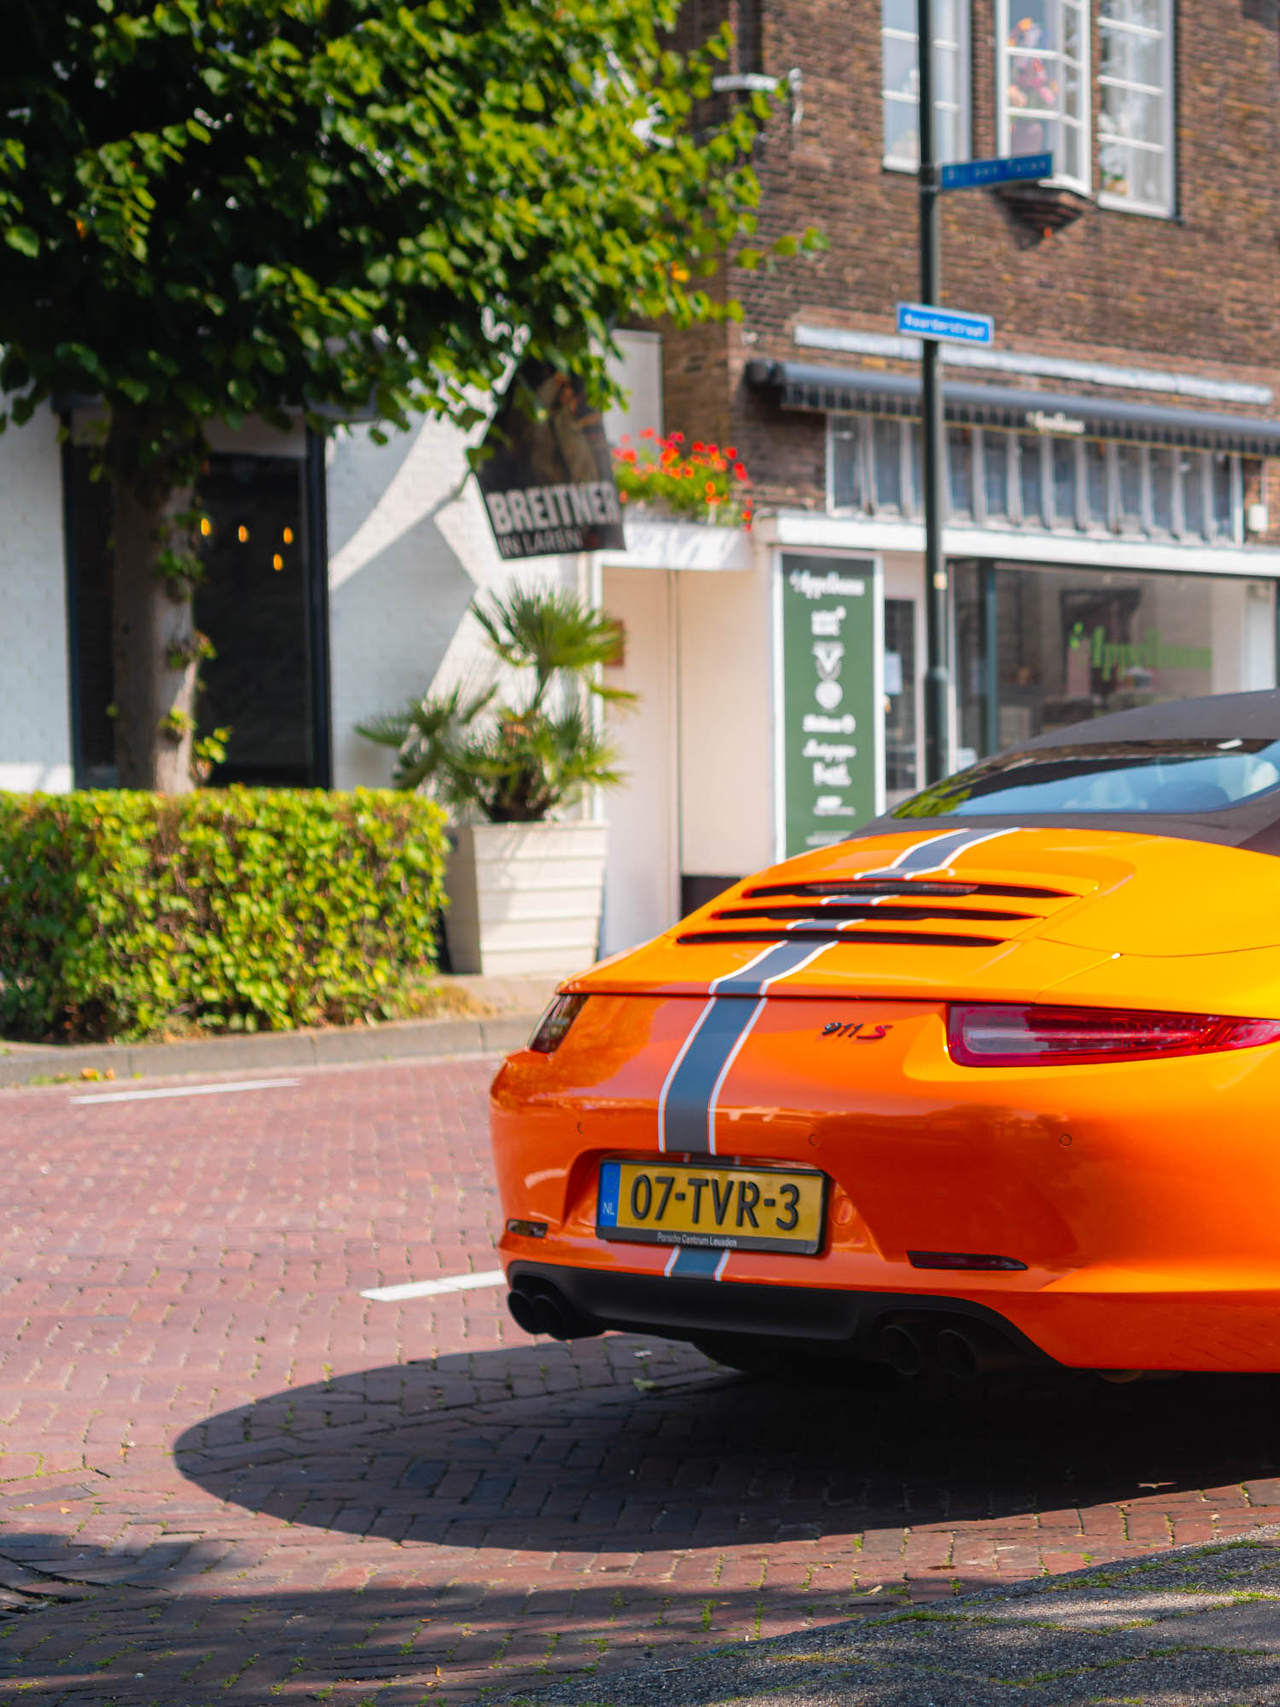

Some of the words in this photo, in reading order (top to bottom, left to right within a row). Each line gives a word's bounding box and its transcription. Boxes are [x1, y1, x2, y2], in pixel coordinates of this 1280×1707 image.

[486, 480, 622, 534] BREITNER
[499, 533, 522, 556] IN
[523, 529, 583, 553] LAREN
[821, 1022, 864, 1039] 911
[856, 1024, 894, 1040] S
[603, 1201, 615, 1215] NL
[630, 1174, 800, 1230] 07-TVR-3
[682, 1233, 708, 1246] Centrum
